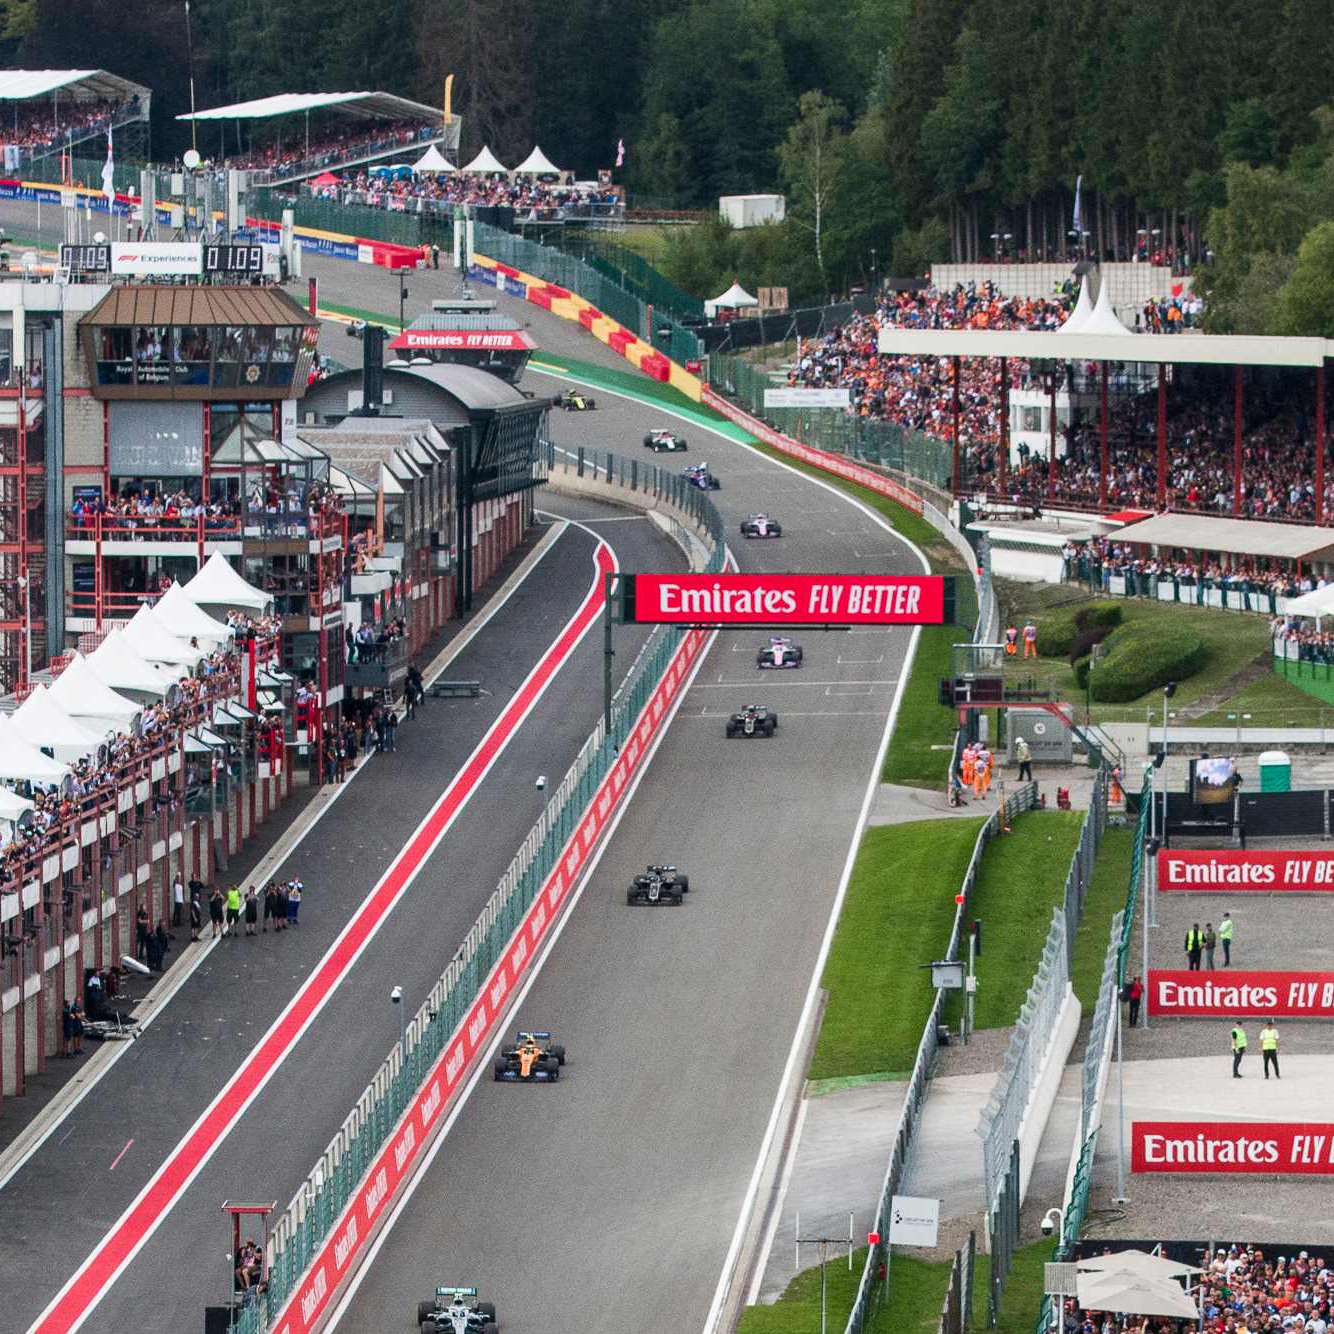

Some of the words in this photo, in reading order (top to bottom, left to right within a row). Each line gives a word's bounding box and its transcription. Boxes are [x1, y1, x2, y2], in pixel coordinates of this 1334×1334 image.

[141, 254, 198, 266] Experiences
[407, 334, 463, 346] Emirates
[175, 366, 188, 374] Club
[659, 583, 796, 614] Emirates
[808, 585, 843, 614] FLY
[847, 585, 921, 614] BETTER
[1168, 859, 1276, 884] Emirates
[1284, 860, 1312, 884] FLY
[1158, 981, 1278, 1008] Emirates
[1287, 982, 1318, 1008] FLY
[1144, 1134, 1279, 1163] Emirates
[1290, 1135, 1326, 1164] FLY
